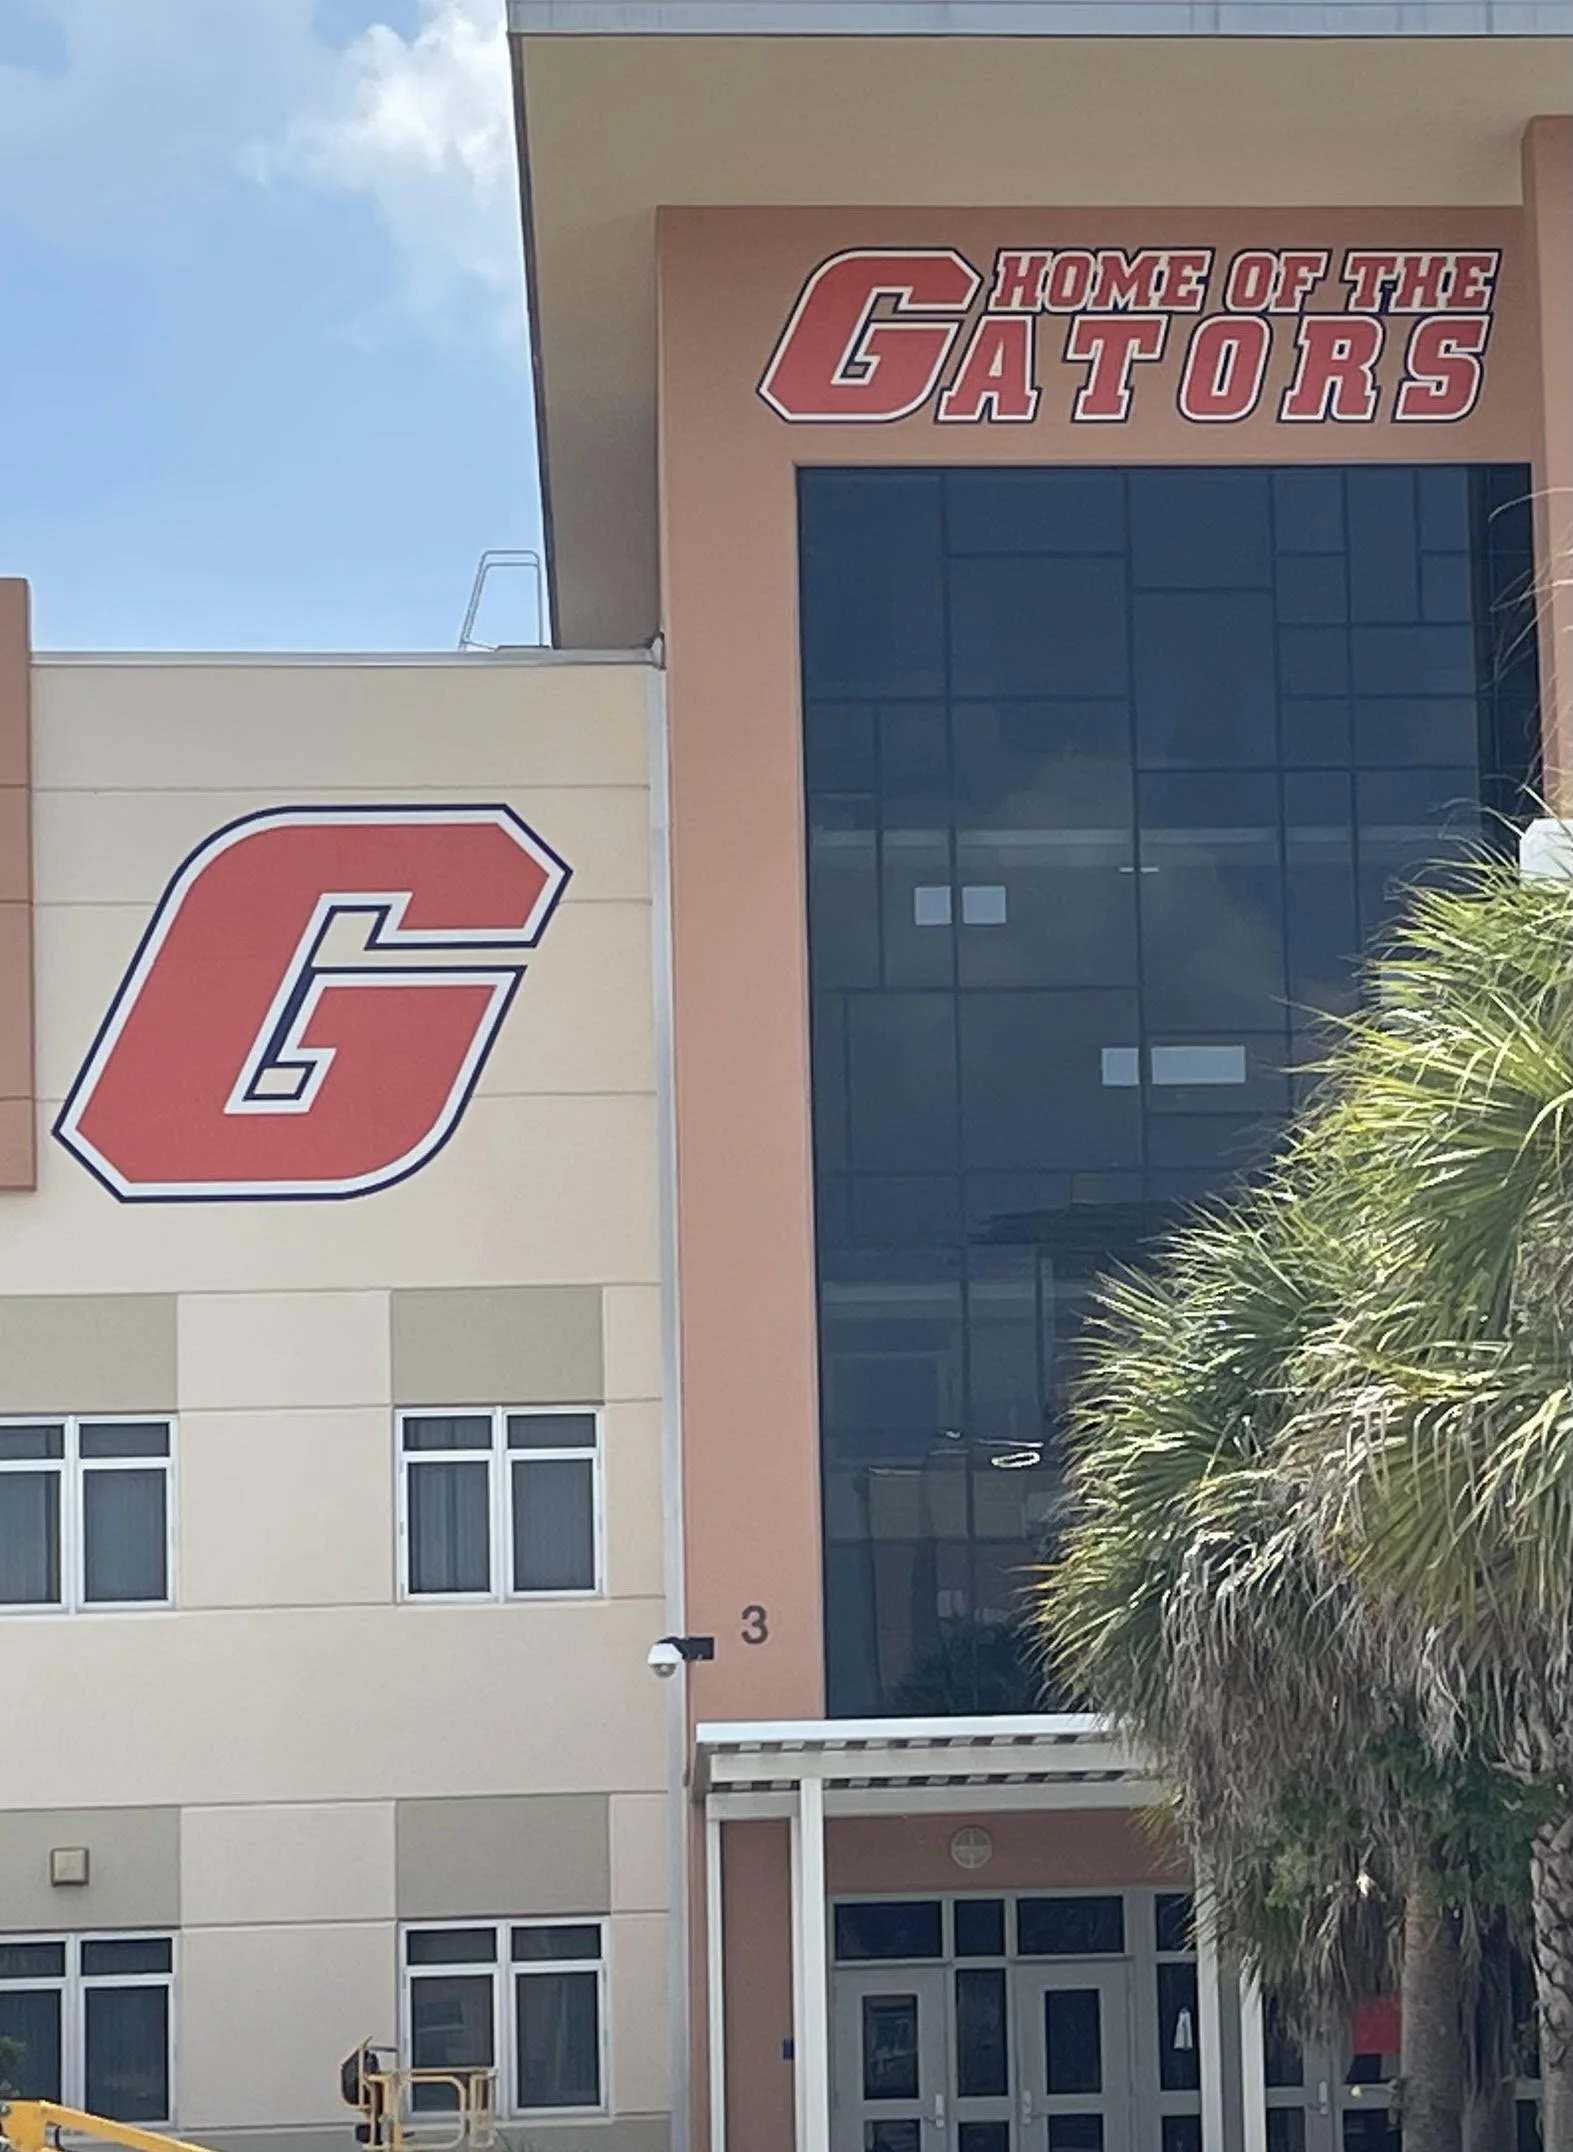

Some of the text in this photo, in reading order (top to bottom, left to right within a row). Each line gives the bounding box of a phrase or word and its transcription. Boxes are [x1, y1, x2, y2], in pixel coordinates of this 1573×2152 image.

[758, 247, 1491, 424] GATORS
[988, 247, 1501, 316] HOME OF THE
[52, 803, 573, 1203] G
[740, 1604, 769, 1645] 3
